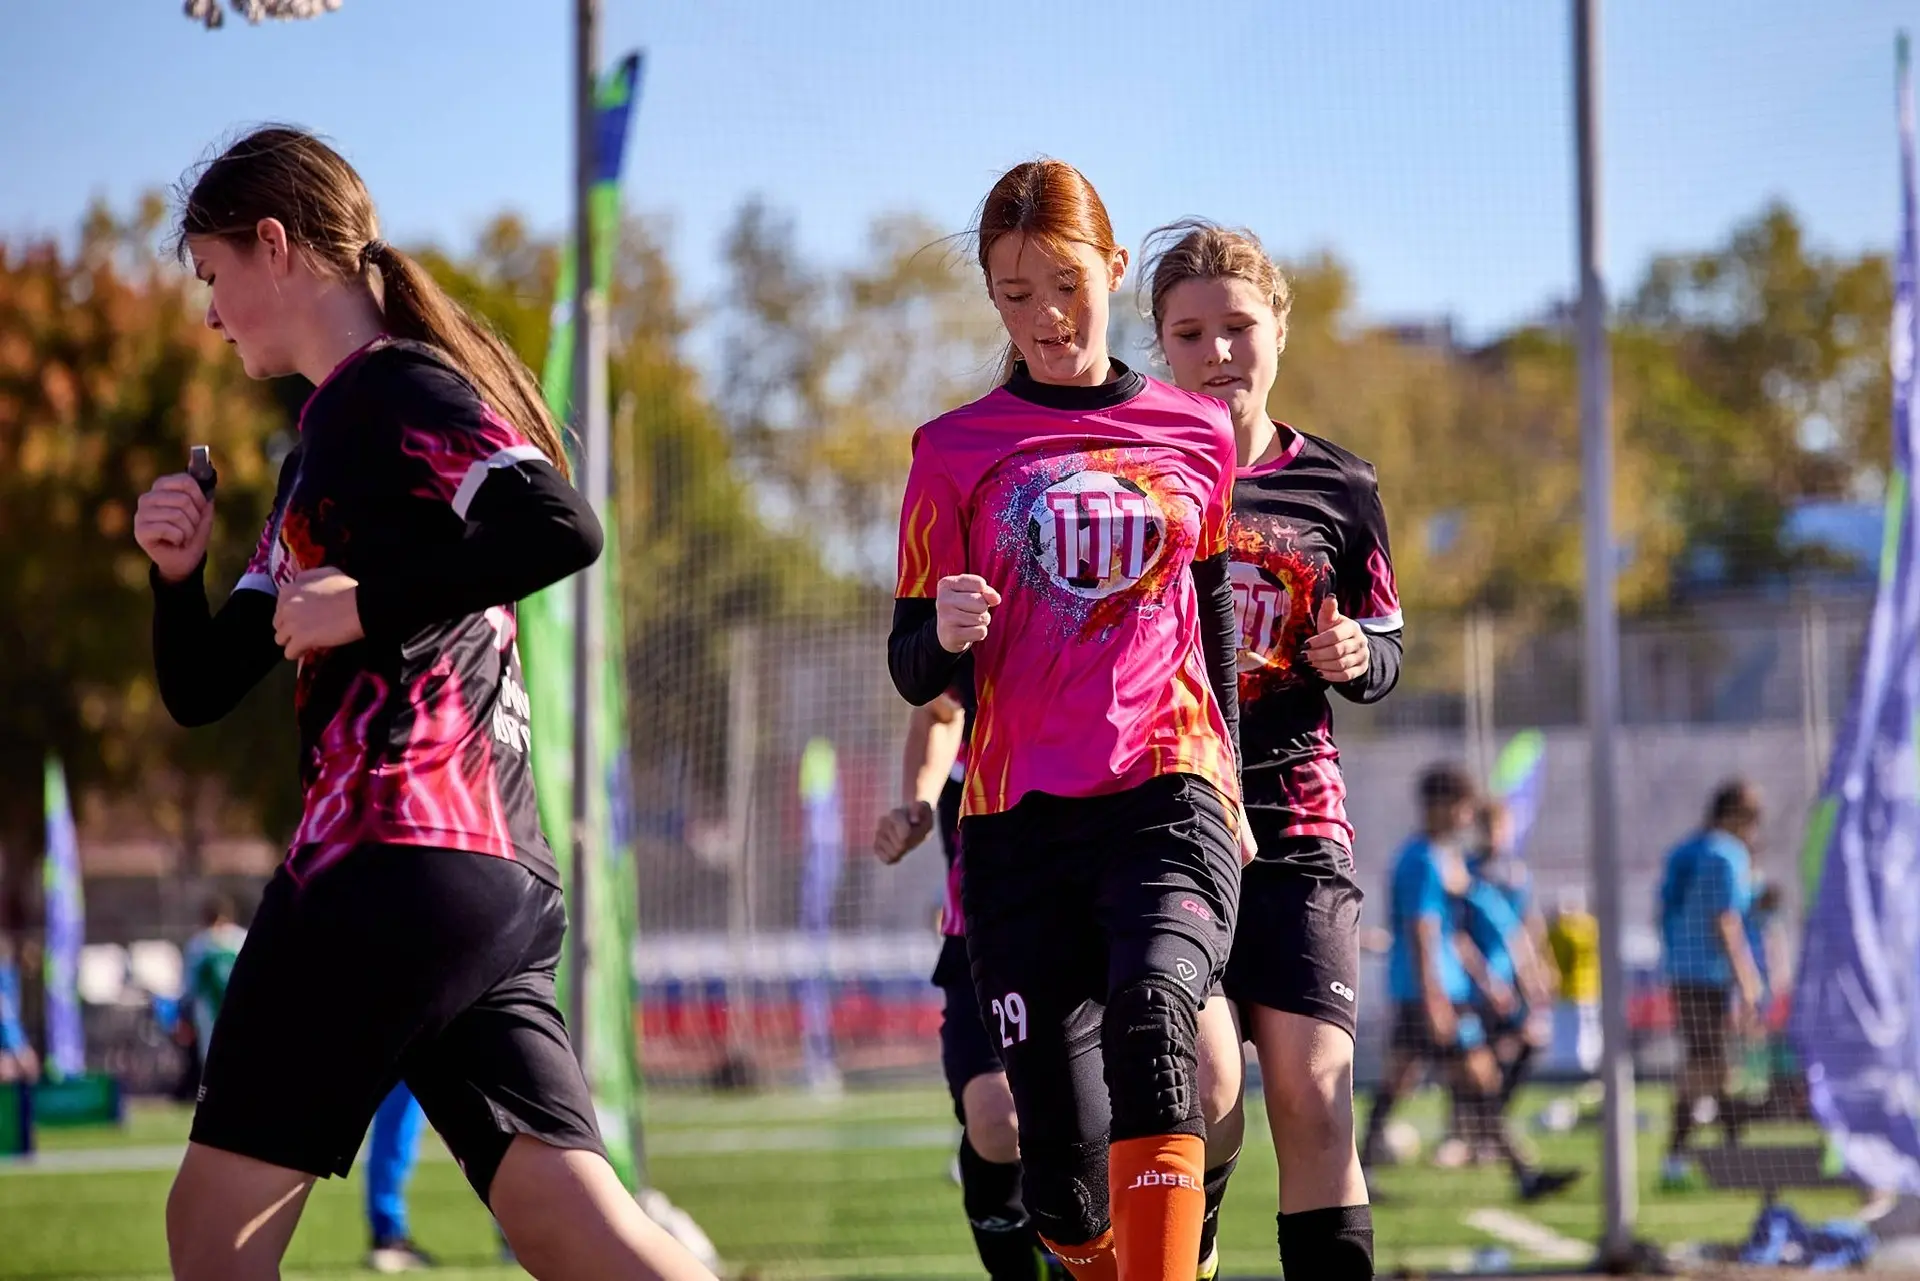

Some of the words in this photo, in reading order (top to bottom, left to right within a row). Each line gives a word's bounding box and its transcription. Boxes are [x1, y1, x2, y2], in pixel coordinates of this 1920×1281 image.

[1231, 583, 1279, 658] 11
[1181, 900, 1210, 921] GS
[1330, 981, 1354, 1002] GS
[991, 992, 1027, 1049] 29
[1128, 1169, 1200, 1192] JÖGEL
